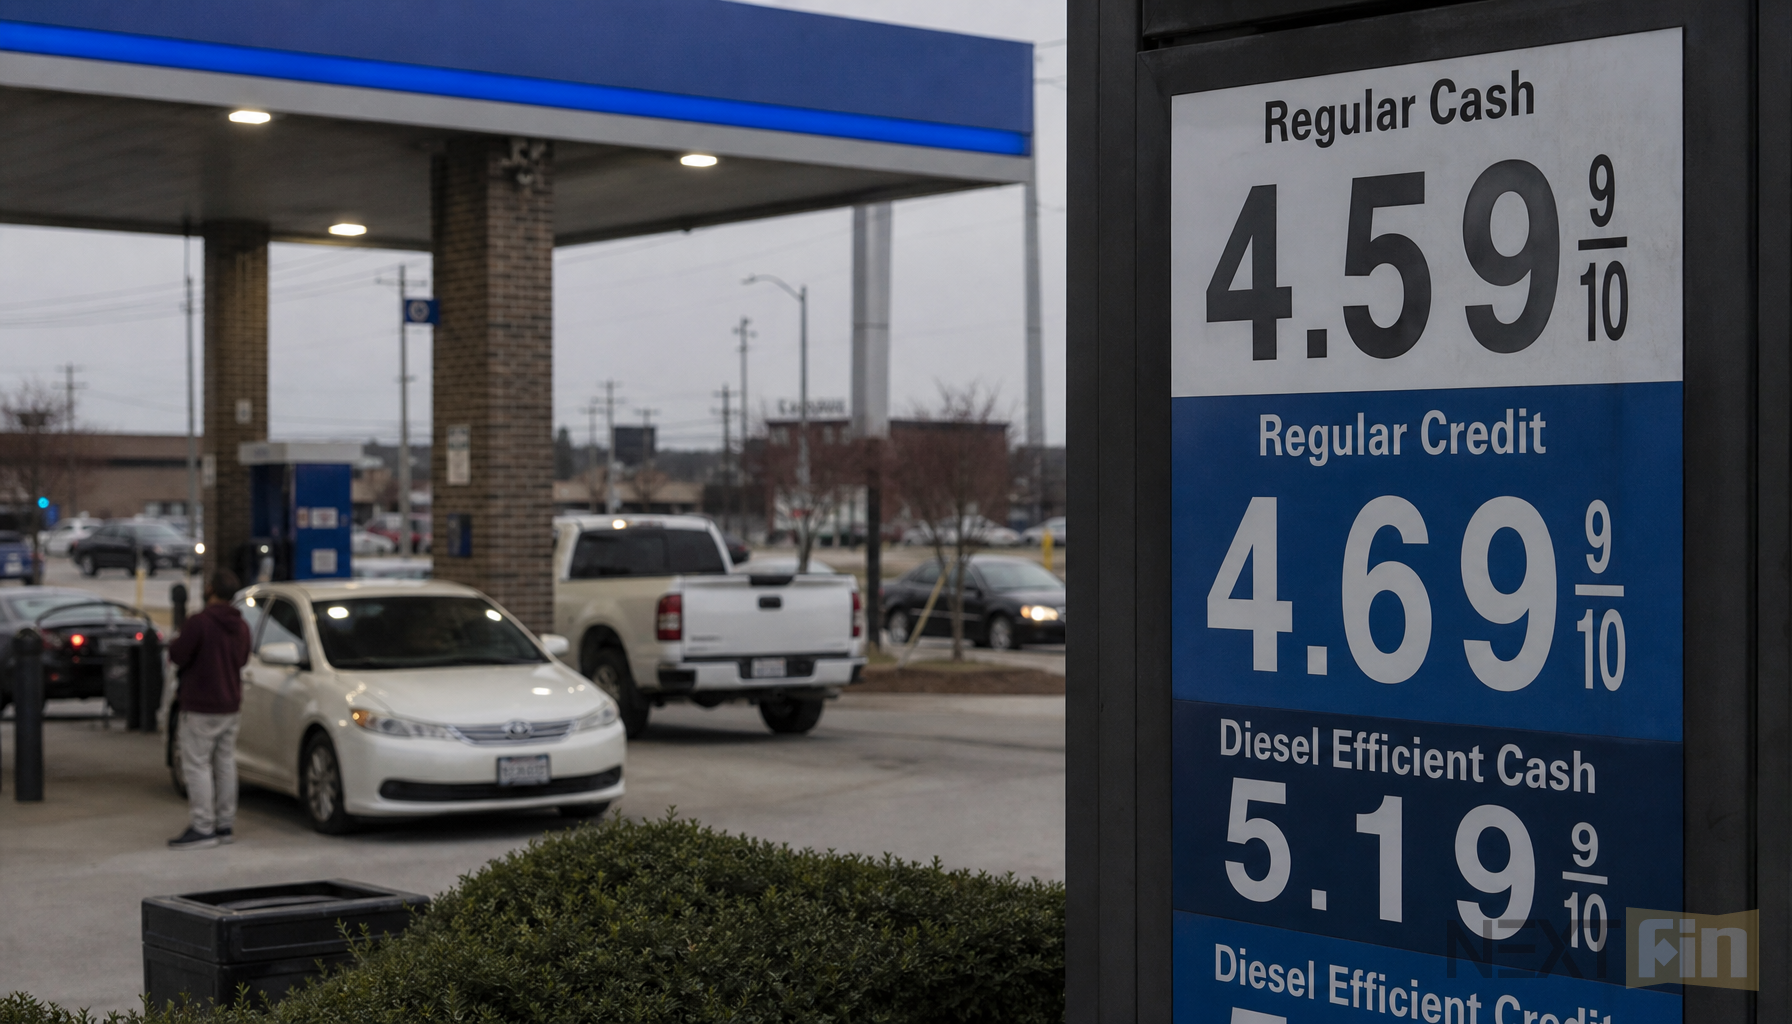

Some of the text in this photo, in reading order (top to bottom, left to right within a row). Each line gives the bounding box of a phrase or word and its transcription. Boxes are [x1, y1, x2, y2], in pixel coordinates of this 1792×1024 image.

[1264, 70, 1535, 148] Regular Cash
[1588, 153, 1616, 228] 9
[1205, 159, 1561, 362] 4.59
[1579, 260, 1629, 342] 10
[1259, 408, 1546, 467] Regular Credit
[1585, 499, 1612, 574] 9
[1207, 495, 1557, 692] 4.69
[1577, 608, 1626, 692] 10
[1220, 718, 1596, 794] Diesel Efficient Cash
[1225, 777, 1536, 940] 5.19
[1571, 822, 1599, 868] 9
[1564, 892, 1608, 952] 10
[1215, 943, 1315, 1000] Diesel
[1329, 964, 1483, 1024] Efficient
